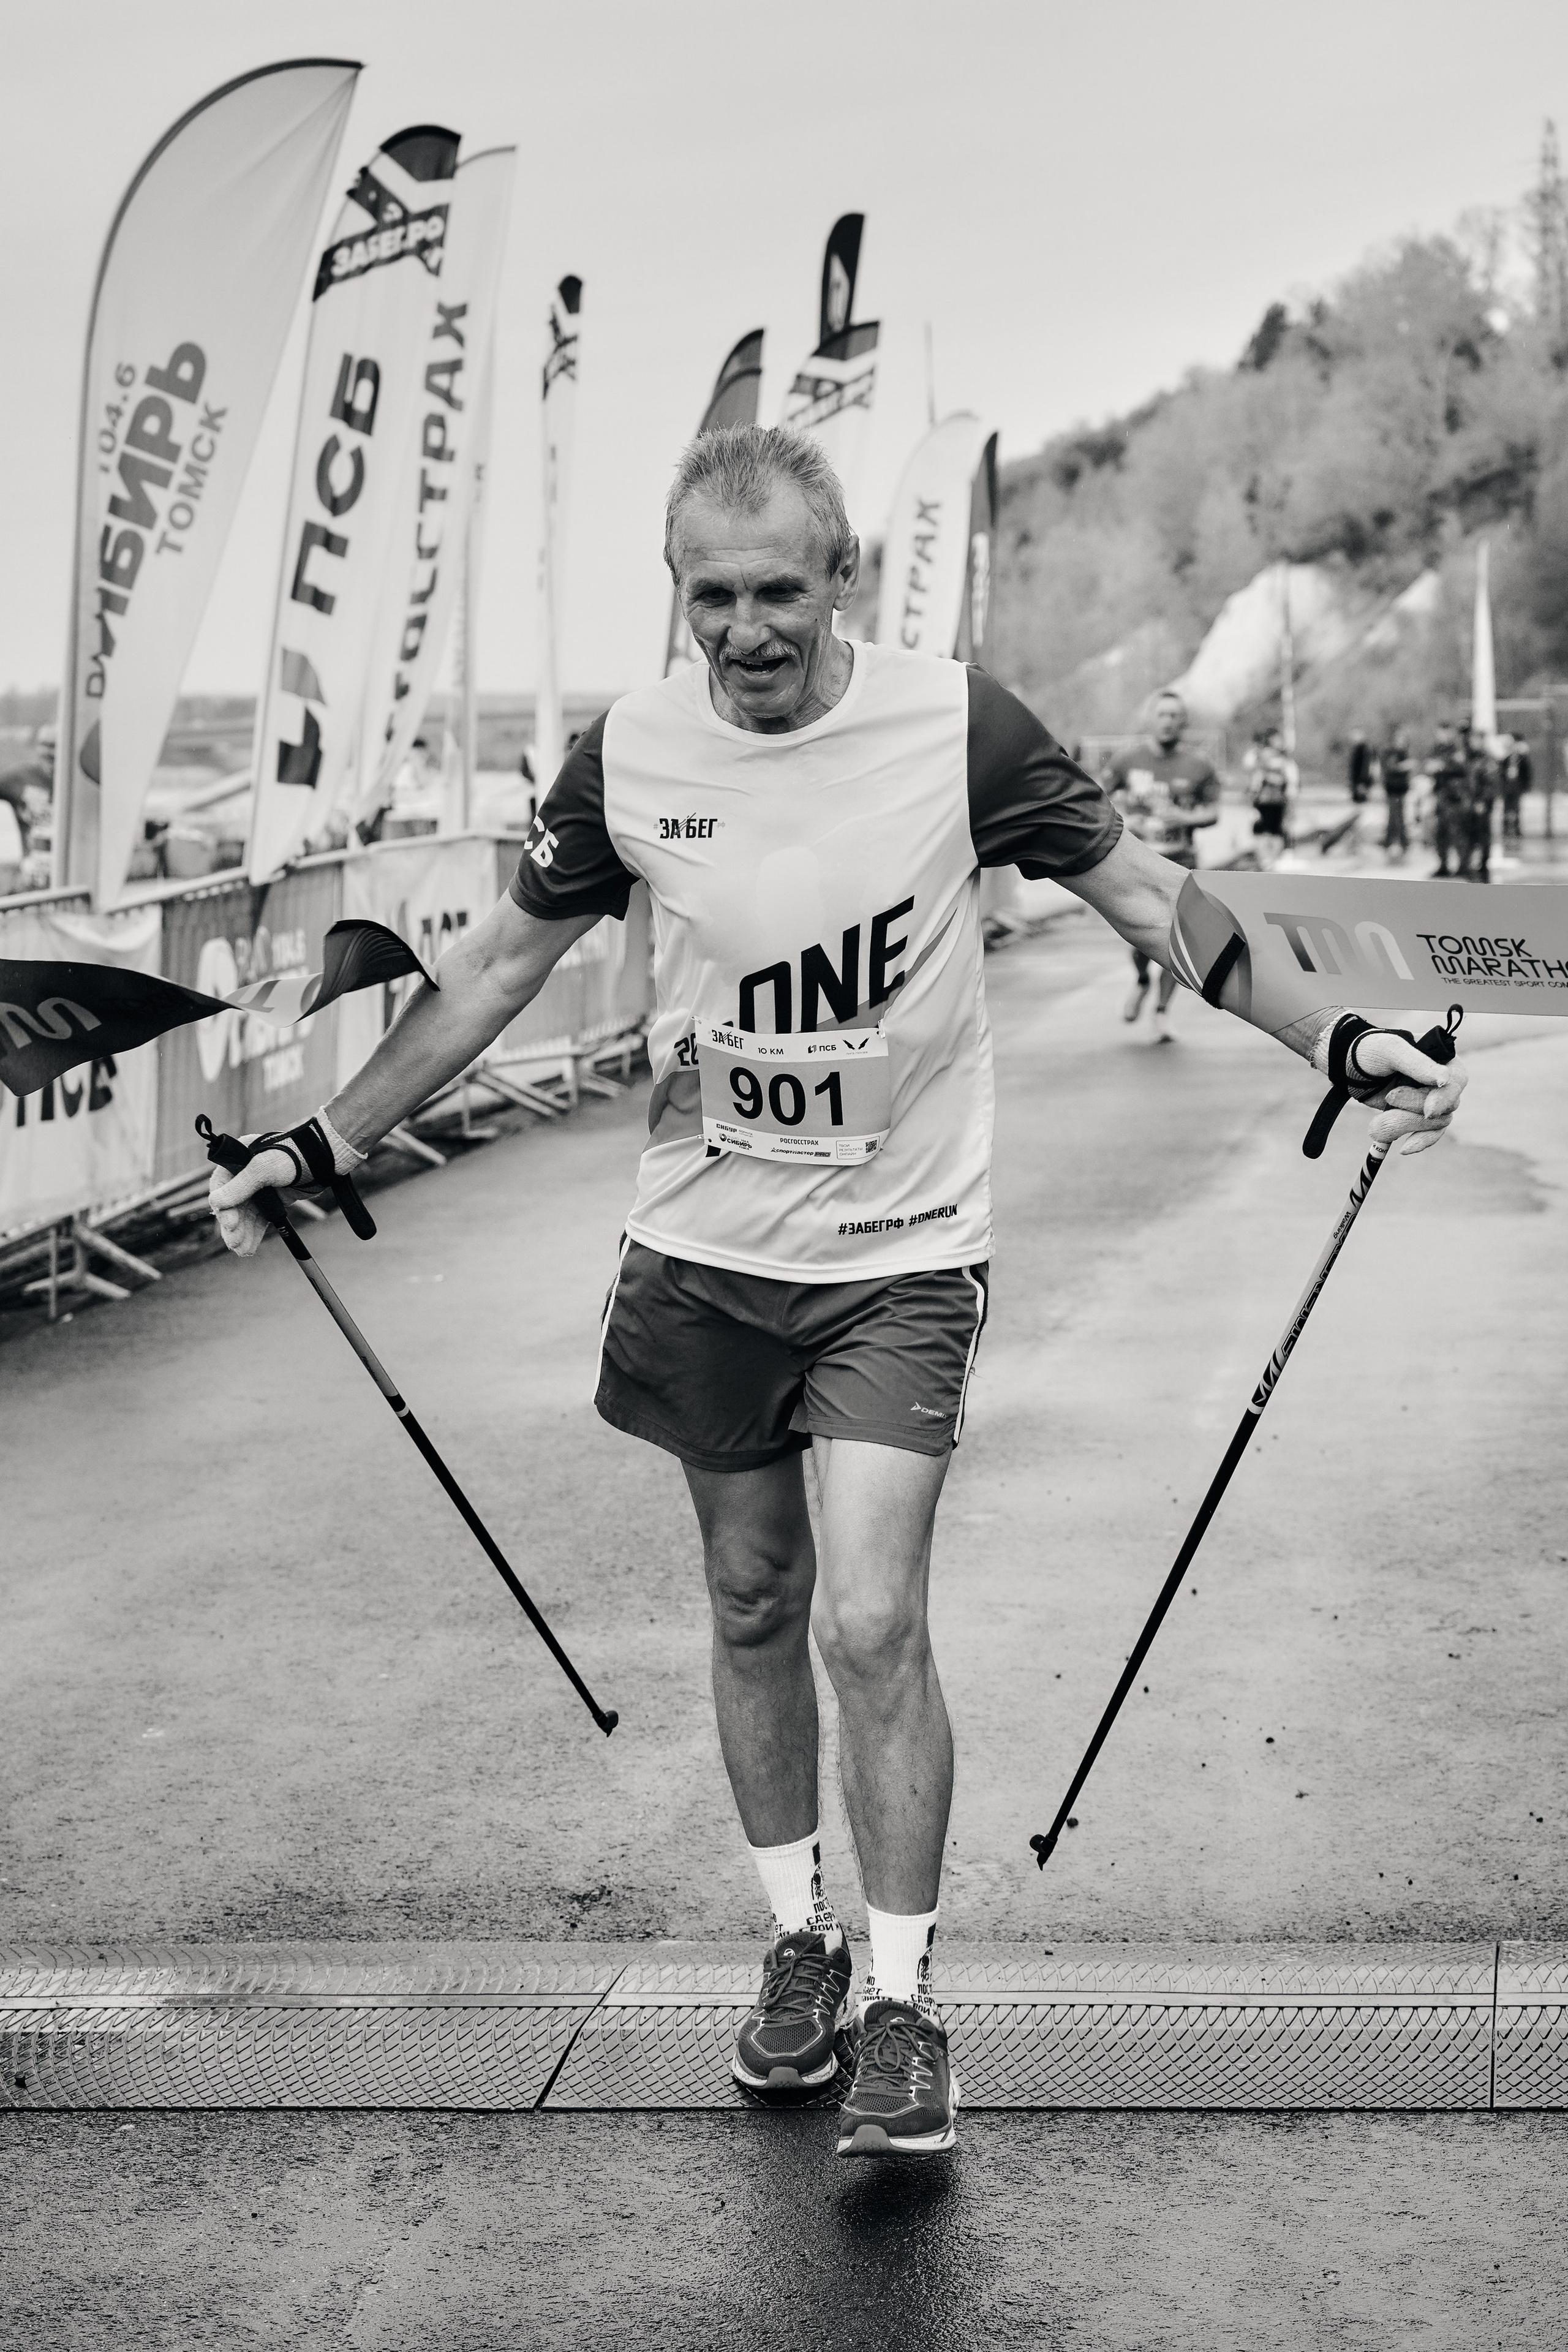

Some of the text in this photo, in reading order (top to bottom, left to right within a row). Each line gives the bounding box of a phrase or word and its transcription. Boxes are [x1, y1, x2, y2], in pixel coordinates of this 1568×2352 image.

[156, 401, 228, 555] ТОМСК
[291, 352, 381, 616] ПСБ
[1415, 933, 1532, 957] TOMSK
[1463, 978, 1511, 987] GREATEST
[729, 1066, 845, 1127] 901
[716, 1123, 737, 1133] СИБУР
[727, 1138, 752, 1149] СИБИРЬ
[1333, 1211, 1352, 1240] Walking
